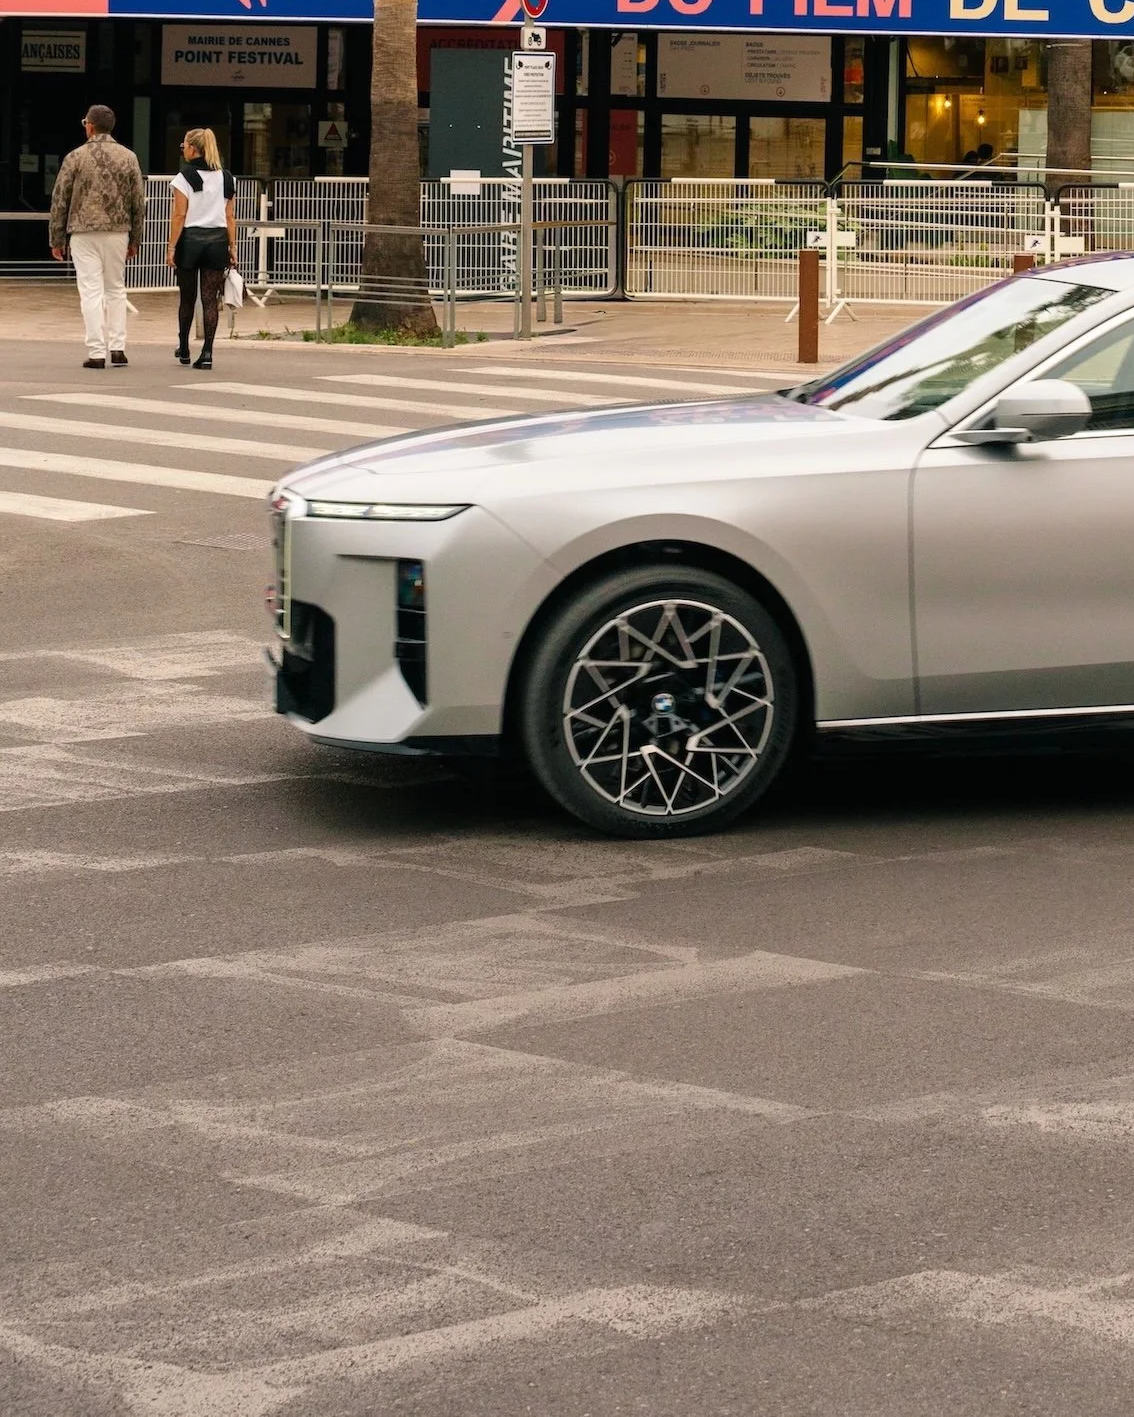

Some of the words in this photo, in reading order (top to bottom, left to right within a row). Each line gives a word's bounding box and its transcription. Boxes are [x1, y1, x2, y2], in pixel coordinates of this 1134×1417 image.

[187, 35, 226, 46] MAIRIE
[229, 36, 243, 46] DE
[246, 37, 290, 47] CANNES
[174, 49, 223, 64] POINT
[227, 50, 304, 65] FESTIVAL
